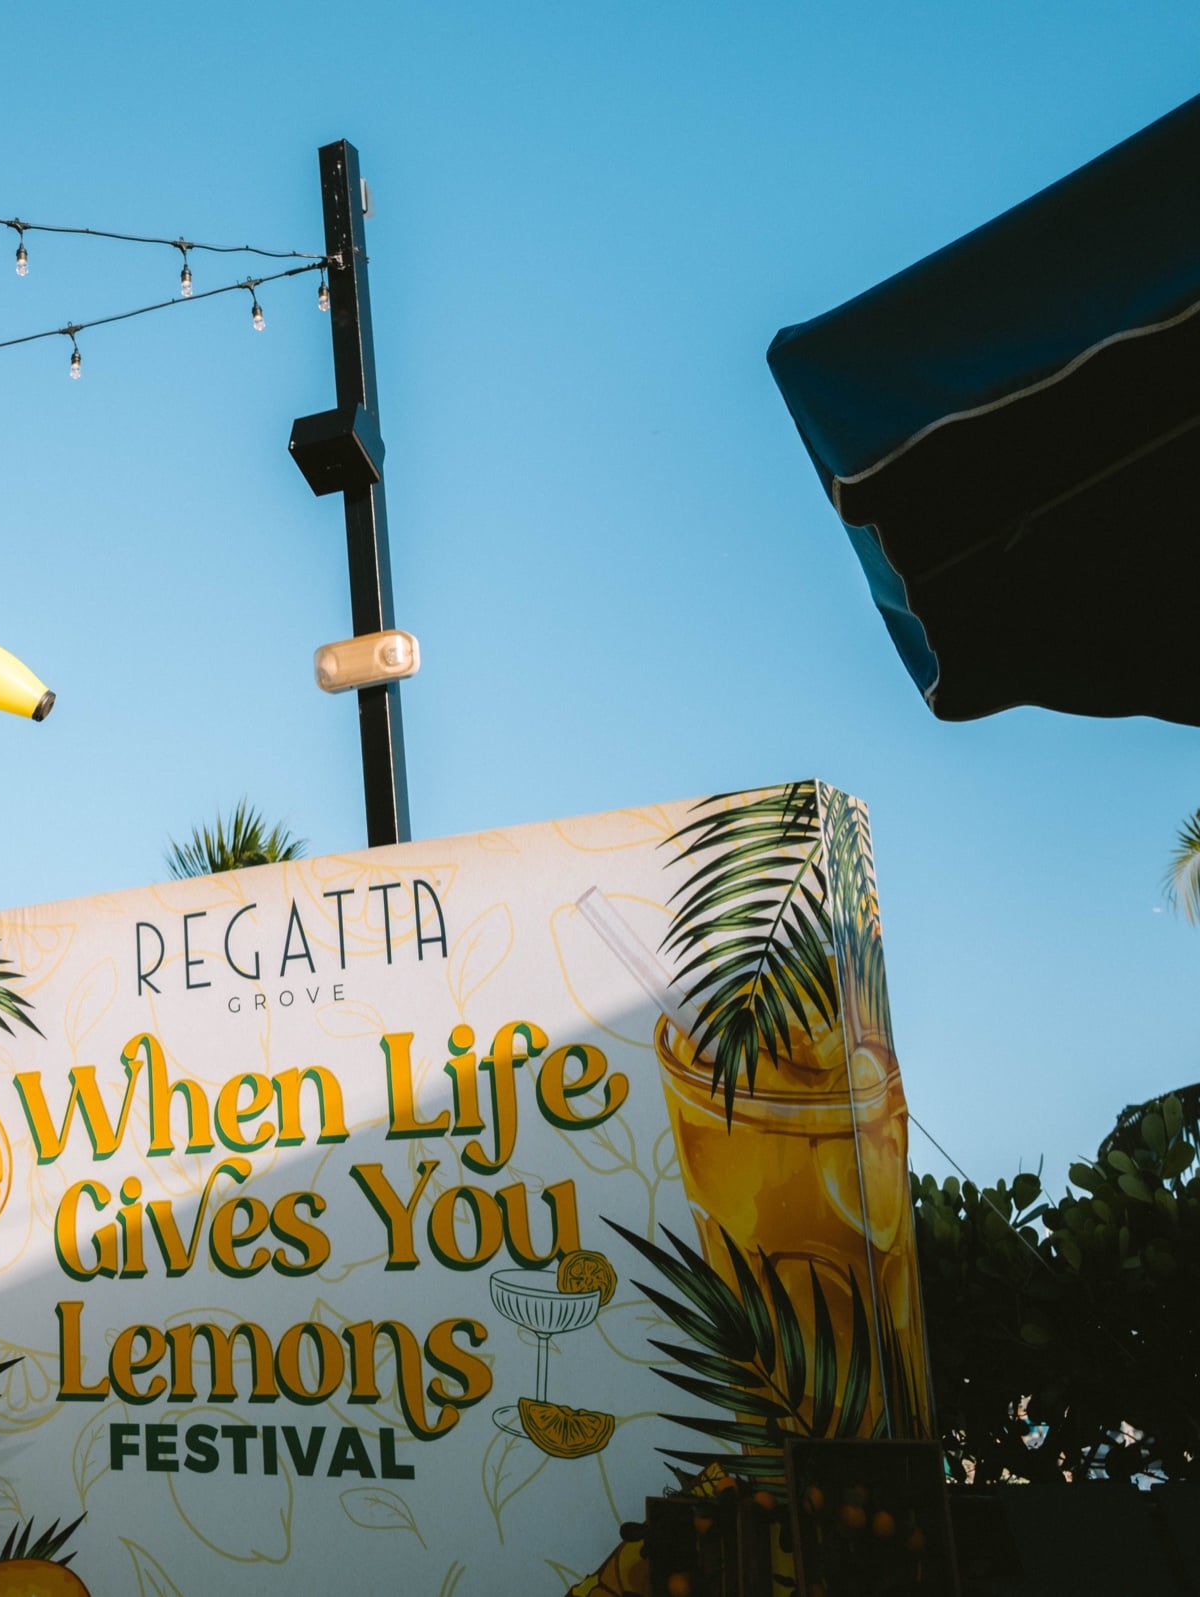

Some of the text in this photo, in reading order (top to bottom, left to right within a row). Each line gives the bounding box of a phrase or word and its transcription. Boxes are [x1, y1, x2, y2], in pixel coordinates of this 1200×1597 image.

[136, 879, 448, 996] REGATTA
[228, 984, 345, 1013] GROVE
[13, 1020, 630, 1176] When Life
[54, 1157, 581, 1282] Gives You
[55, 1301, 494, 1442] Lemons
[109, 1423, 415, 1480] FESTIVAL
